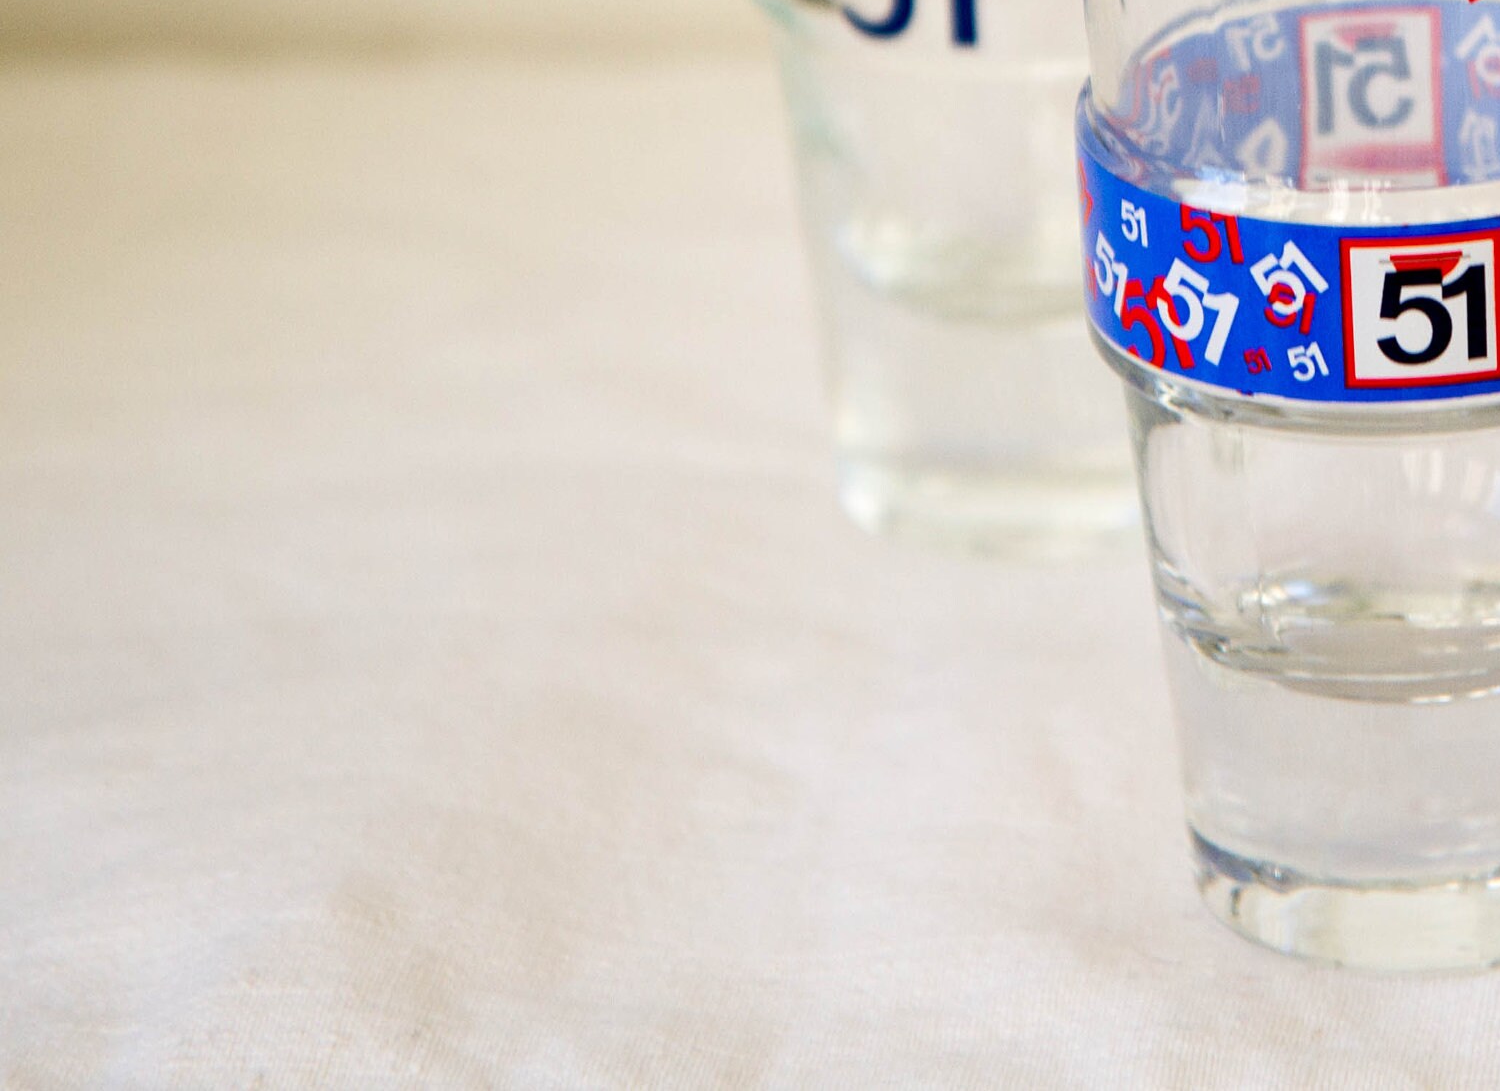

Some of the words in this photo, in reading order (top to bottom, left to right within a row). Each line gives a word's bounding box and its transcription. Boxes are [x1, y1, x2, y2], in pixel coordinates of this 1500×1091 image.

[1120, 198, 1149, 248] 51
[1179, 202, 1245, 265] 51
[1094, 229, 1129, 319] 51
[1249, 240, 1330, 316] 51
[1377, 250, 1488, 366] 51
[1156, 257, 1240, 366] 51
[1243, 345, 1273, 376] 51
[1287, 341, 1331, 382] 51
